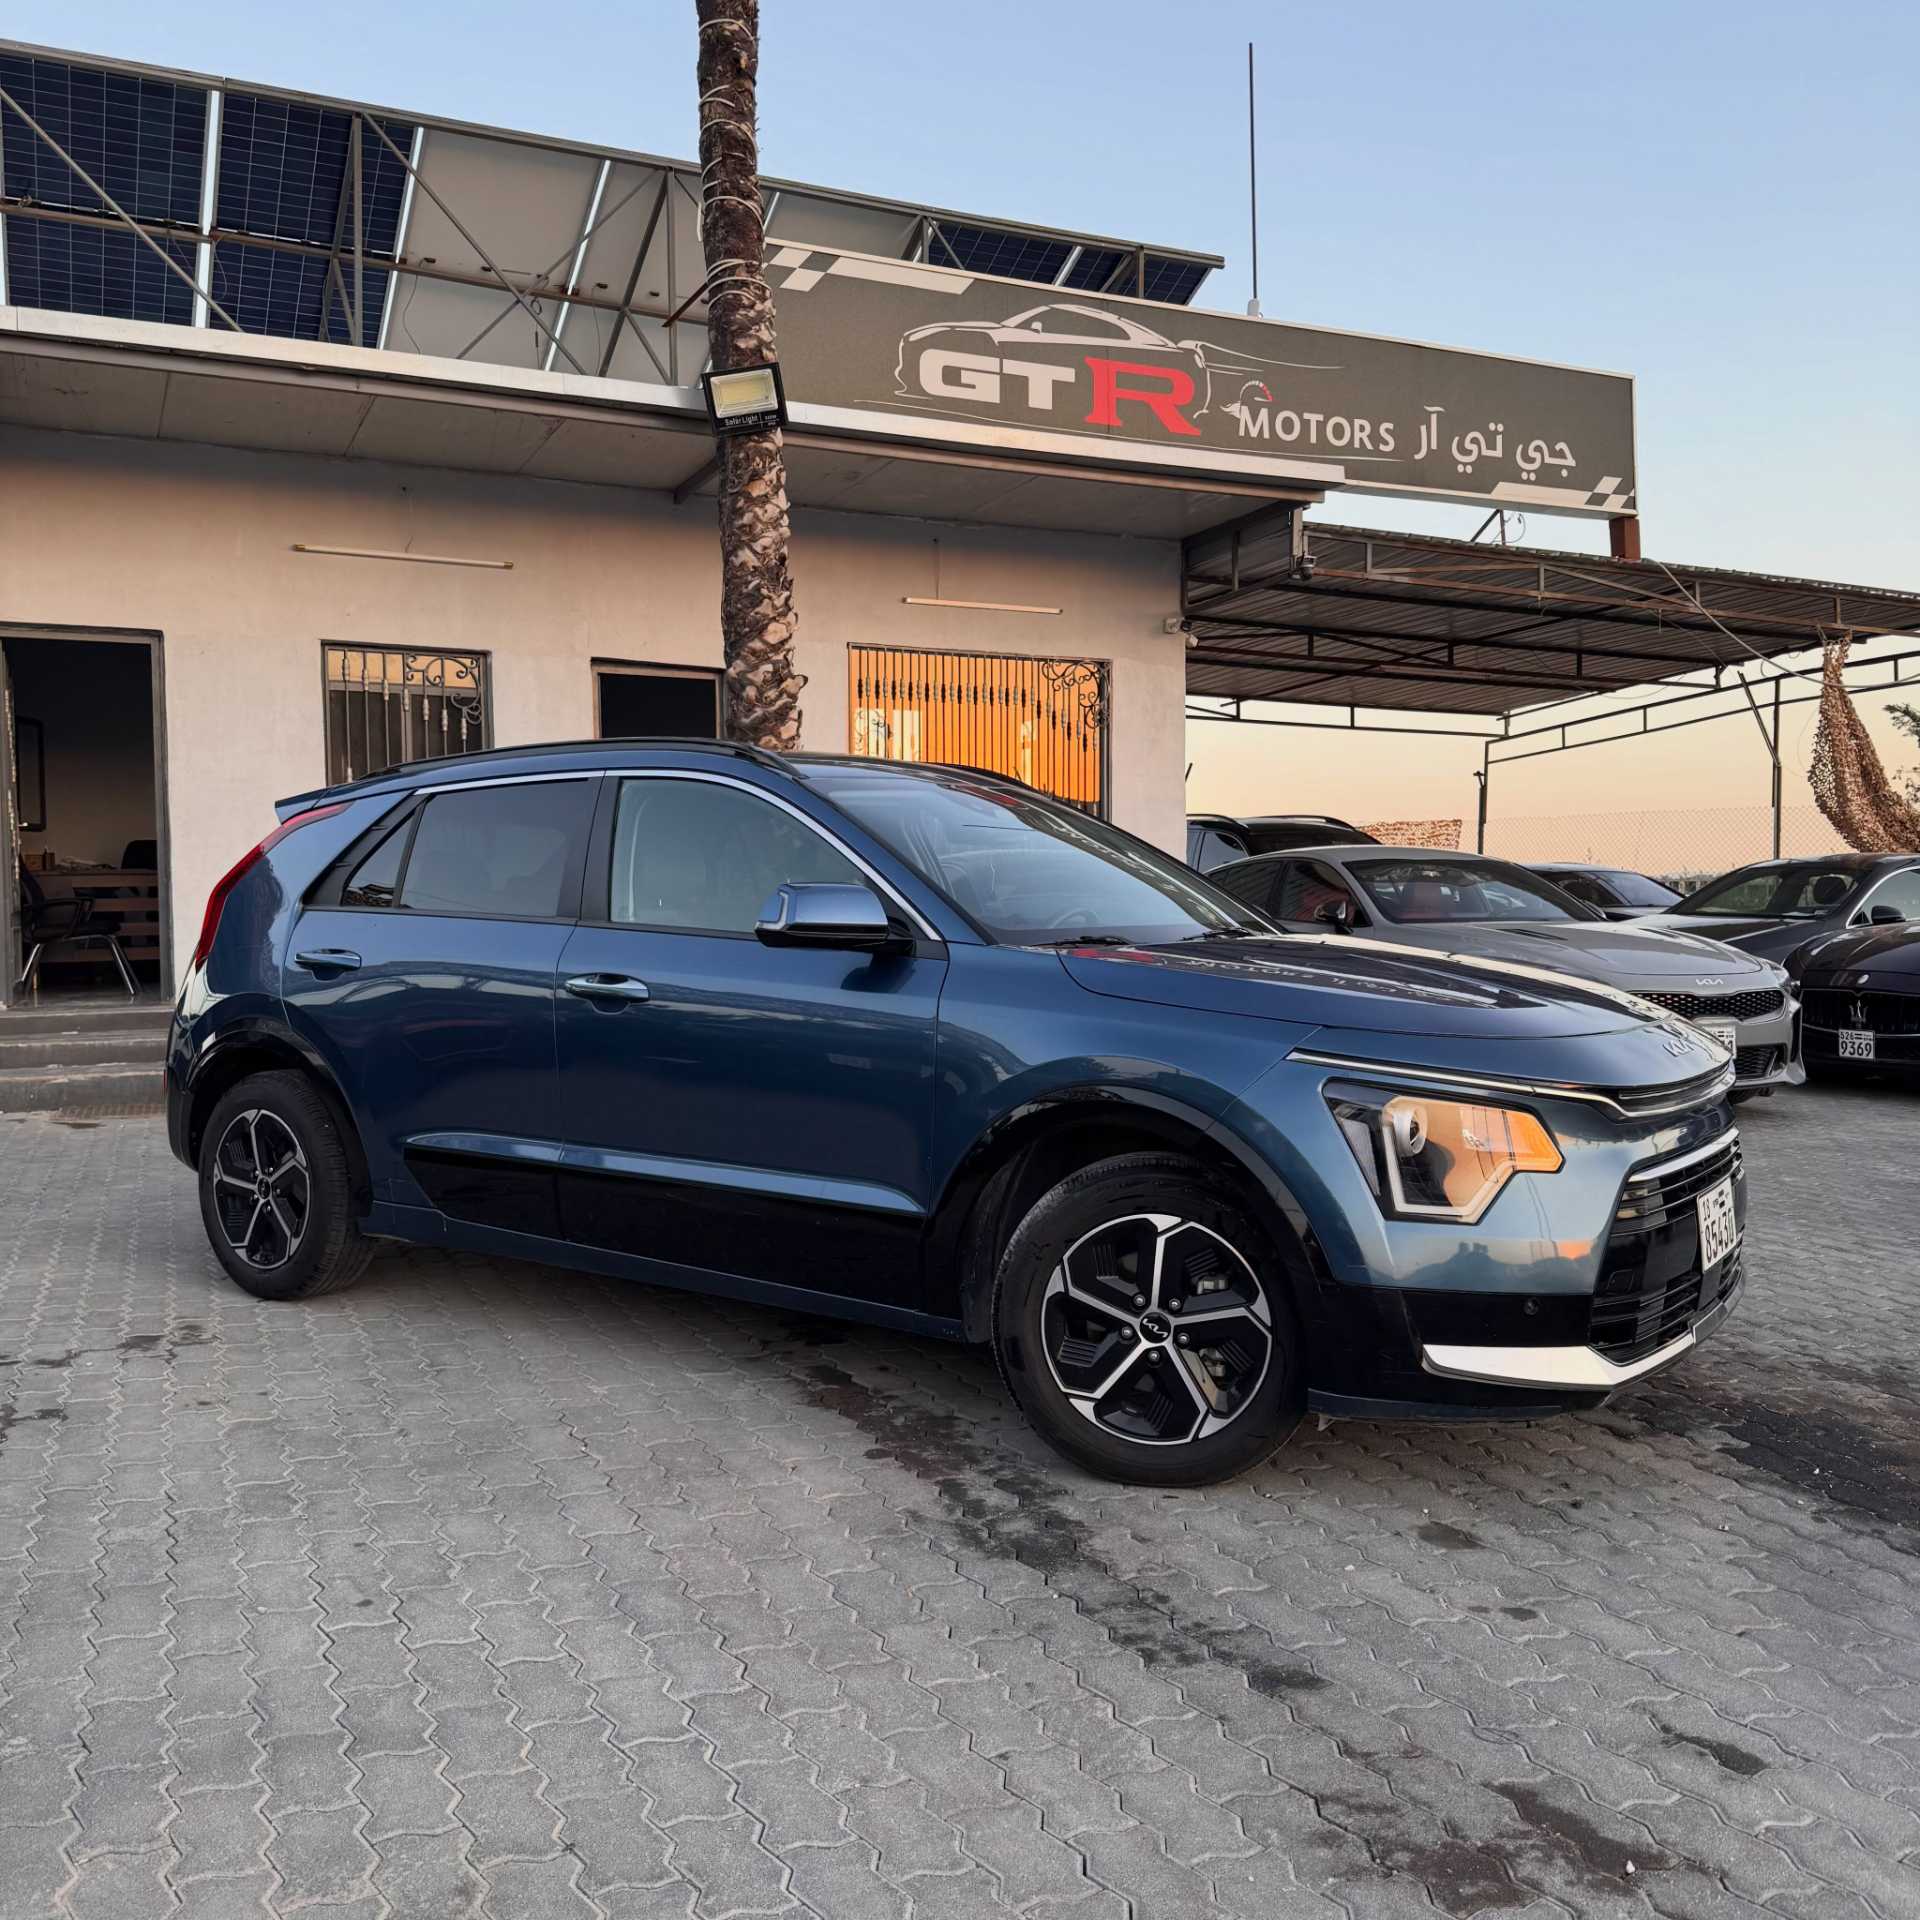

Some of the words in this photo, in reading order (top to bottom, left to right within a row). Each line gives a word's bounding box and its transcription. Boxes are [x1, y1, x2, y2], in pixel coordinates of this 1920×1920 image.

[919, 348, 1201, 437] GTR
[1238, 405, 1396, 452] MOTORS
[1413, 404, 1446, 460] آر
[1451, 421, 1504, 474] تي
[1514, 438, 1577, 481] جي
[1840, 1040, 1872, 1057] 9369
[1702, 1197, 1711, 1221] 18
[1704, 1207, 1735, 1264] 85430
